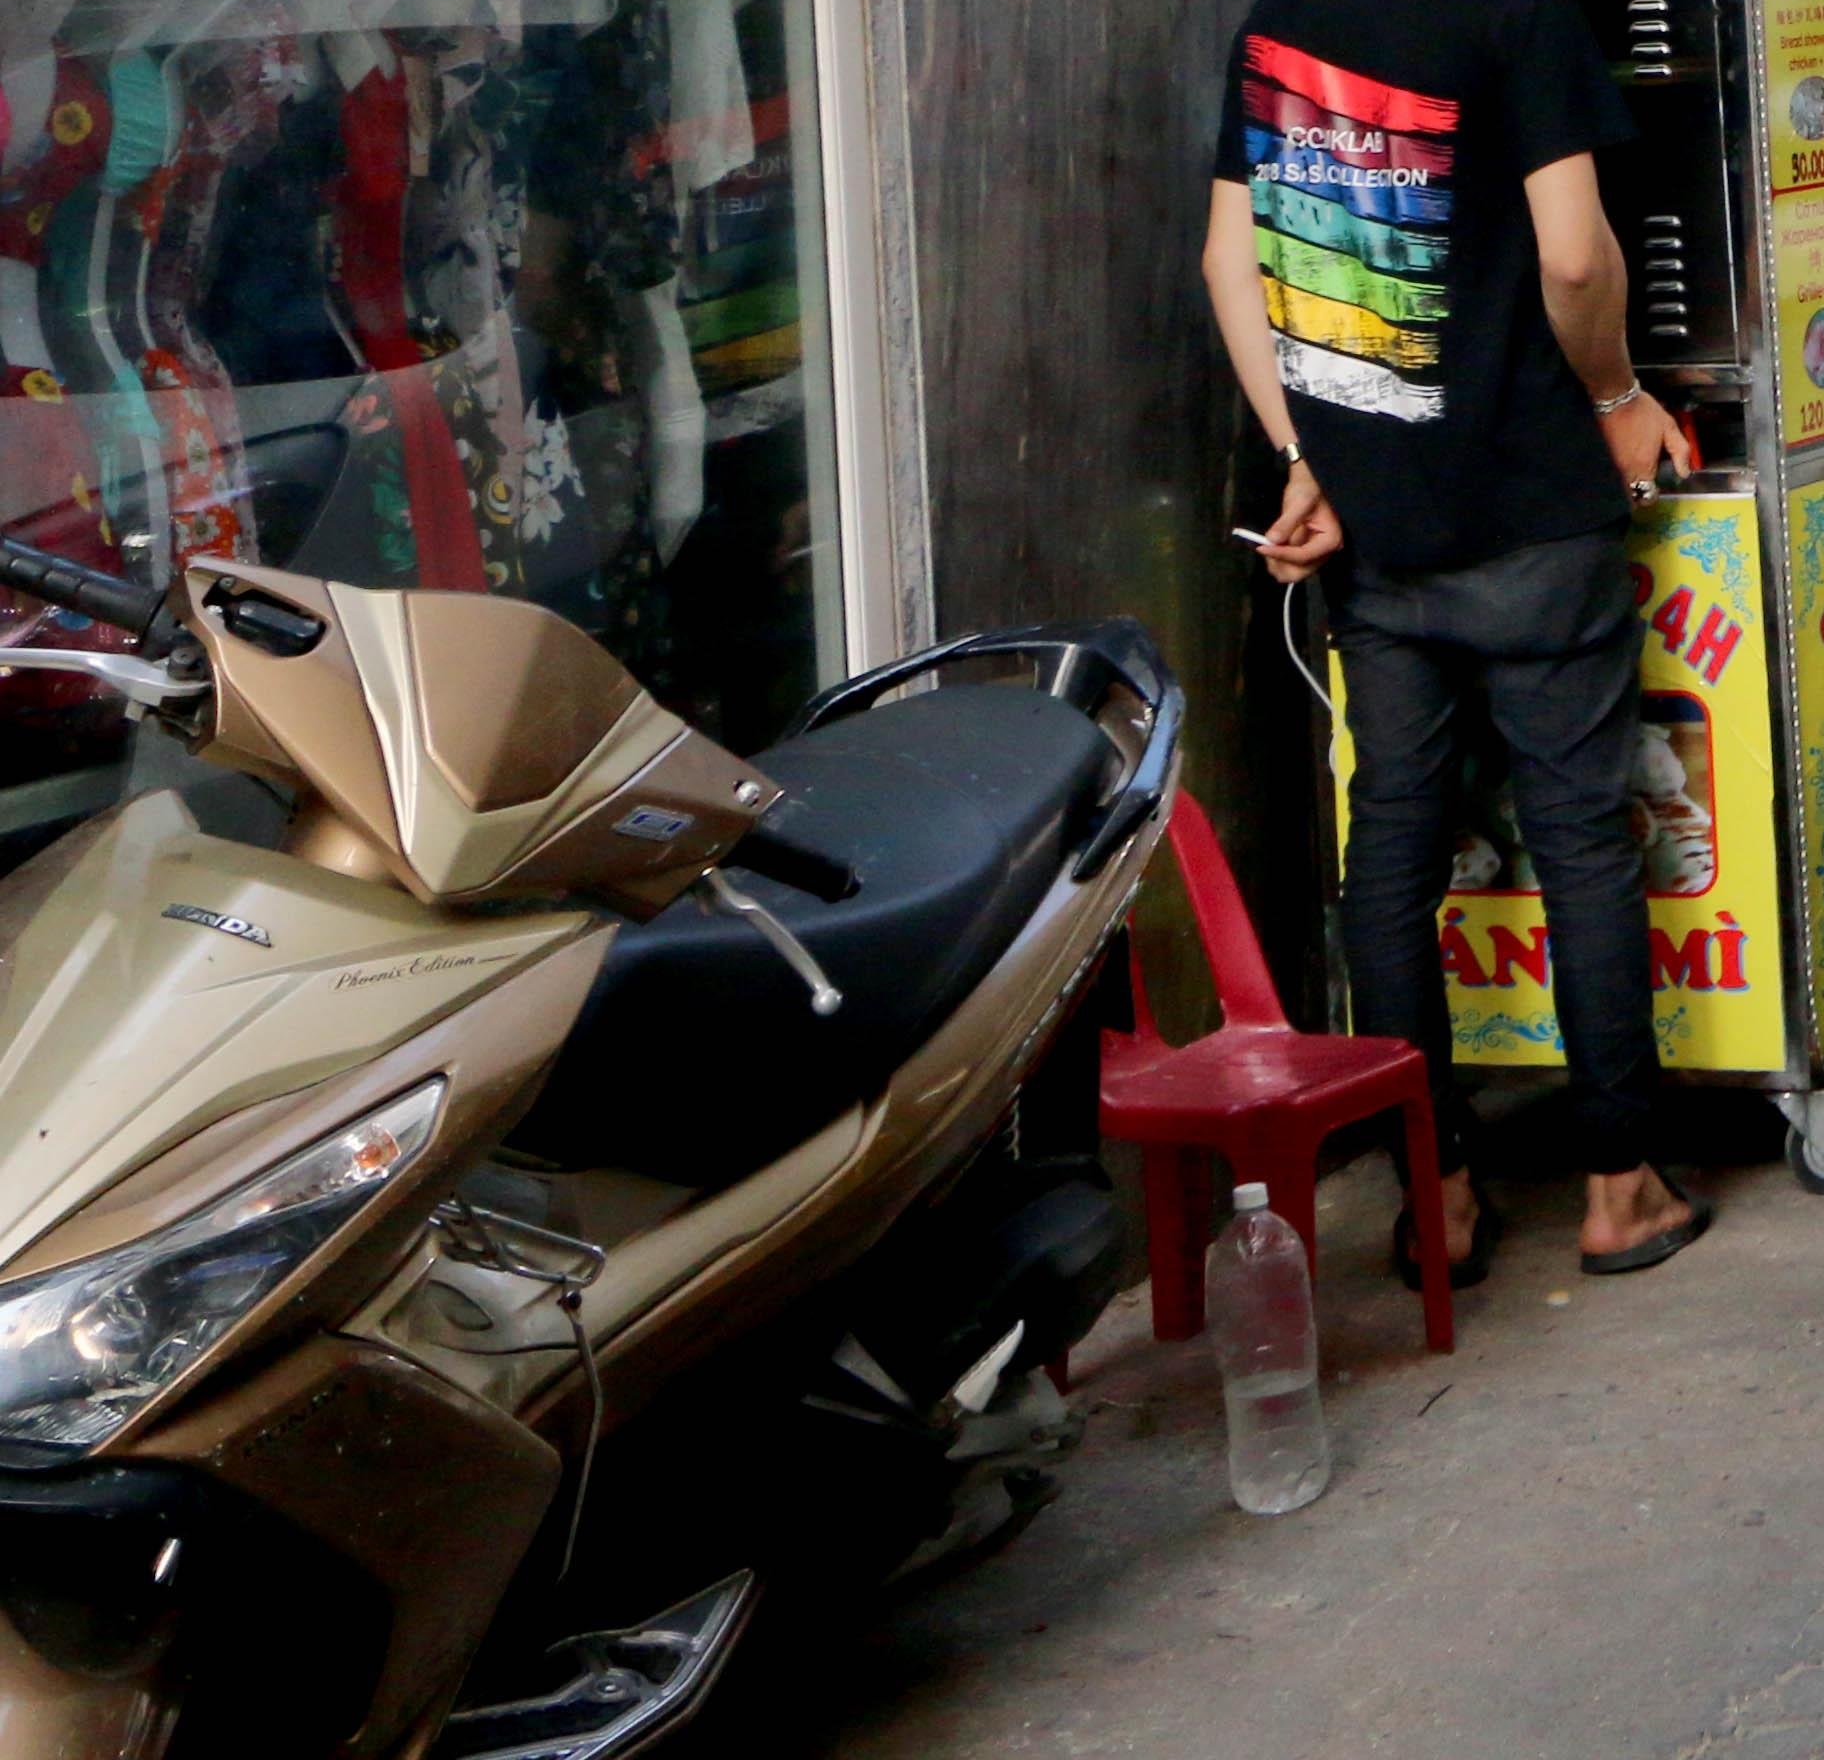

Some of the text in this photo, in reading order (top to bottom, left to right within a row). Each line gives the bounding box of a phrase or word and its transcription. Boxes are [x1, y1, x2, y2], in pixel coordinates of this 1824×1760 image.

[335, 956, 477, 991] Phoenix Edition
[1440, 907, 1550, 986] ÁN
